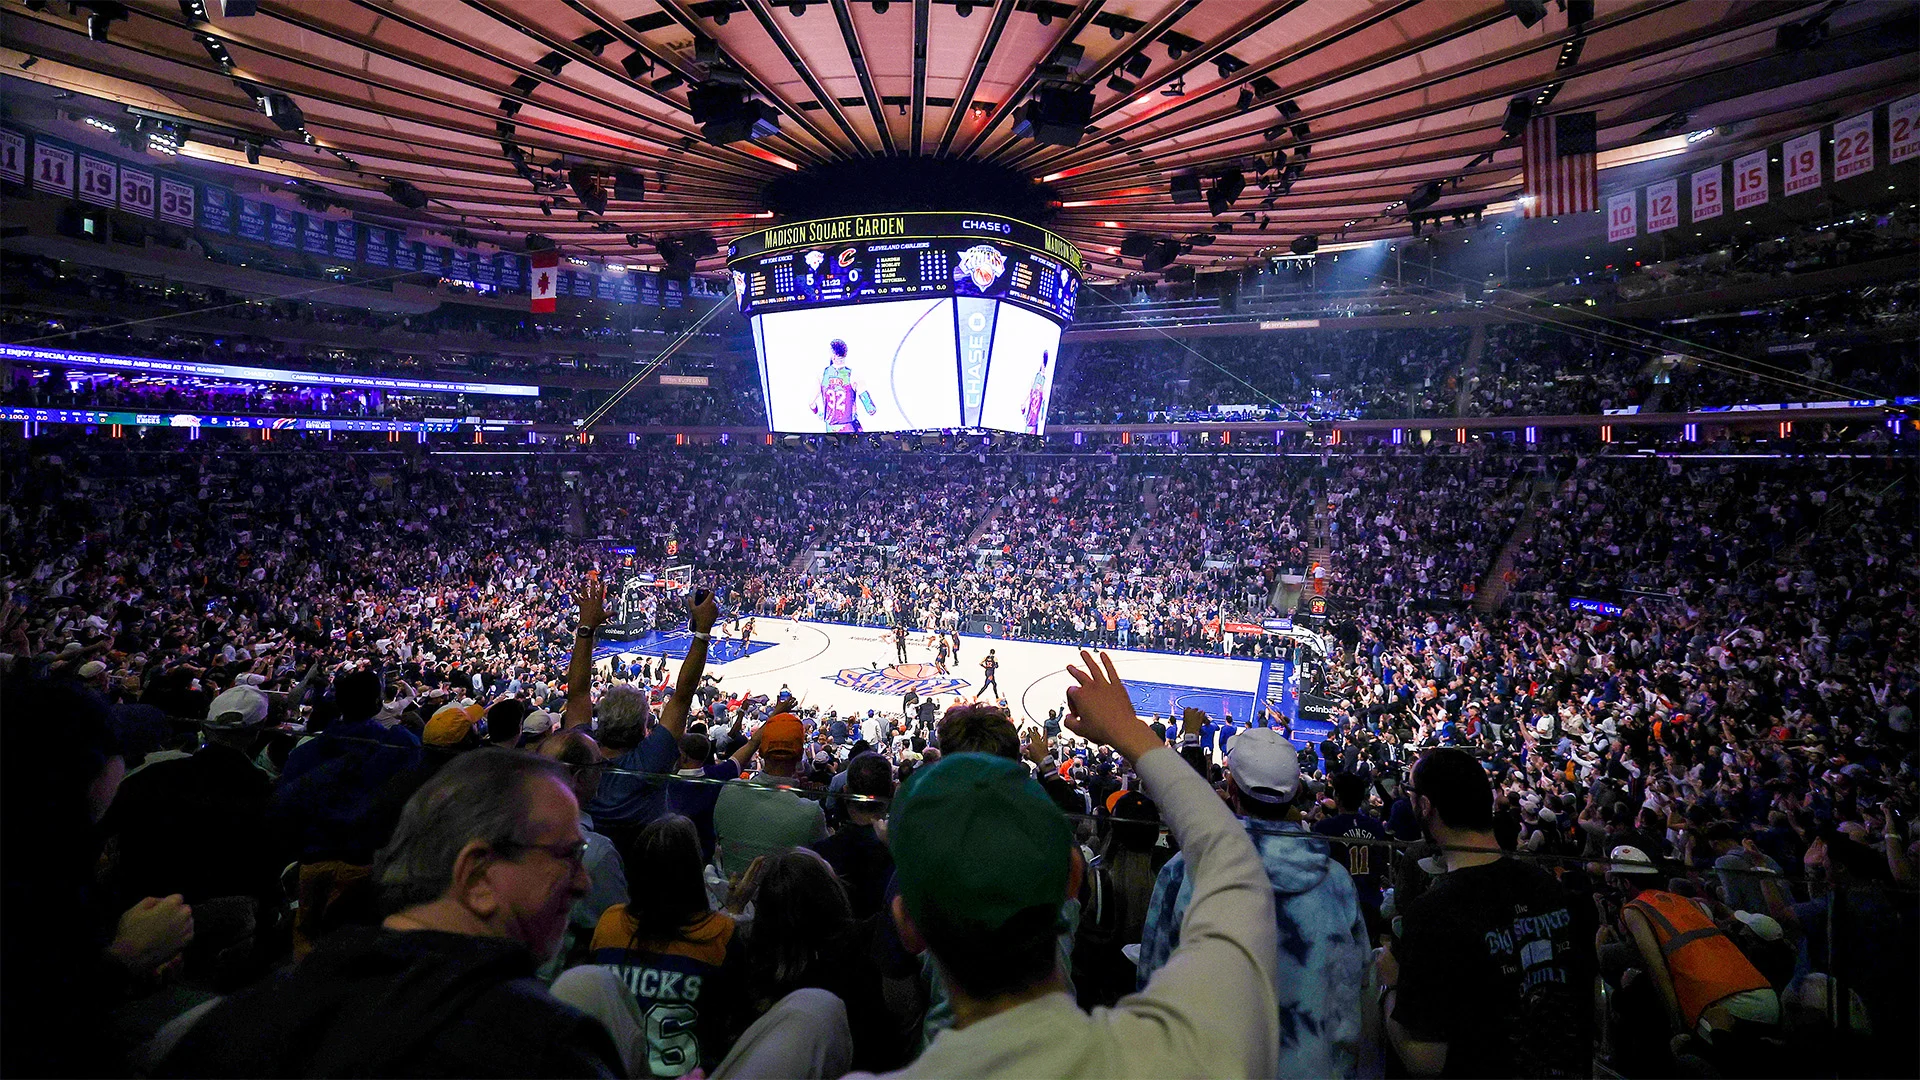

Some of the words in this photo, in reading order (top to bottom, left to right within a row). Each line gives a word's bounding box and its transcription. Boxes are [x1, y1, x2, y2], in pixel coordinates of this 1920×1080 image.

[1837, 131, 1870, 162] 22
[40, 157, 66, 186] 11
[1790, 151, 1814, 177] 19
[1836, 157, 1871, 177] KNICKS
[84, 169, 112, 196] 19
[1740, 167, 1763, 193] 15
[1786, 173, 1819, 192] KNICKS
[123, 180, 151, 206] 30
[163, 191, 192, 217] 35
[1697, 181, 1717, 206] 15
[1736, 190, 1767, 207] KNICKS
[1612, 205, 1632, 227] 10
[1652, 195, 1672, 217] 12
[1694, 202, 1722, 219] KNICKS
[764, 226, 806, 249] MADISON
[809, 221, 852, 241] SQUARE
[855, 217, 905, 237] GARDEN
[962, 220, 1001, 232] CHASE
[1609, 225, 1636, 239] KNICKS
[1649, 215, 1677, 230] KNICKS
[1044, 232, 1070, 260] MADISON
[806, 274, 815, 285] 5
[822, 279, 841, 287] 11:22
[848, 270, 859, 281] 0
[7, 349, 33, 357] ENJOY
[34, 351, 67, 360] SPECIAL
[67, 354, 98, 364] ACCESS,
[99, 358, 132, 366] SAVINGS
[133, 360, 150, 368] AND
[151, 362, 172, 370] MORE
[196, 366, 225, 374] GARDEN
[965, 335, 985, 408] CHASE
[825, 389, 846, 411] 32
[1349, 845, 1370, 876] 11
[1485, 928, 1513, 955] Big
[643, 1002, 700, 1079] 6
